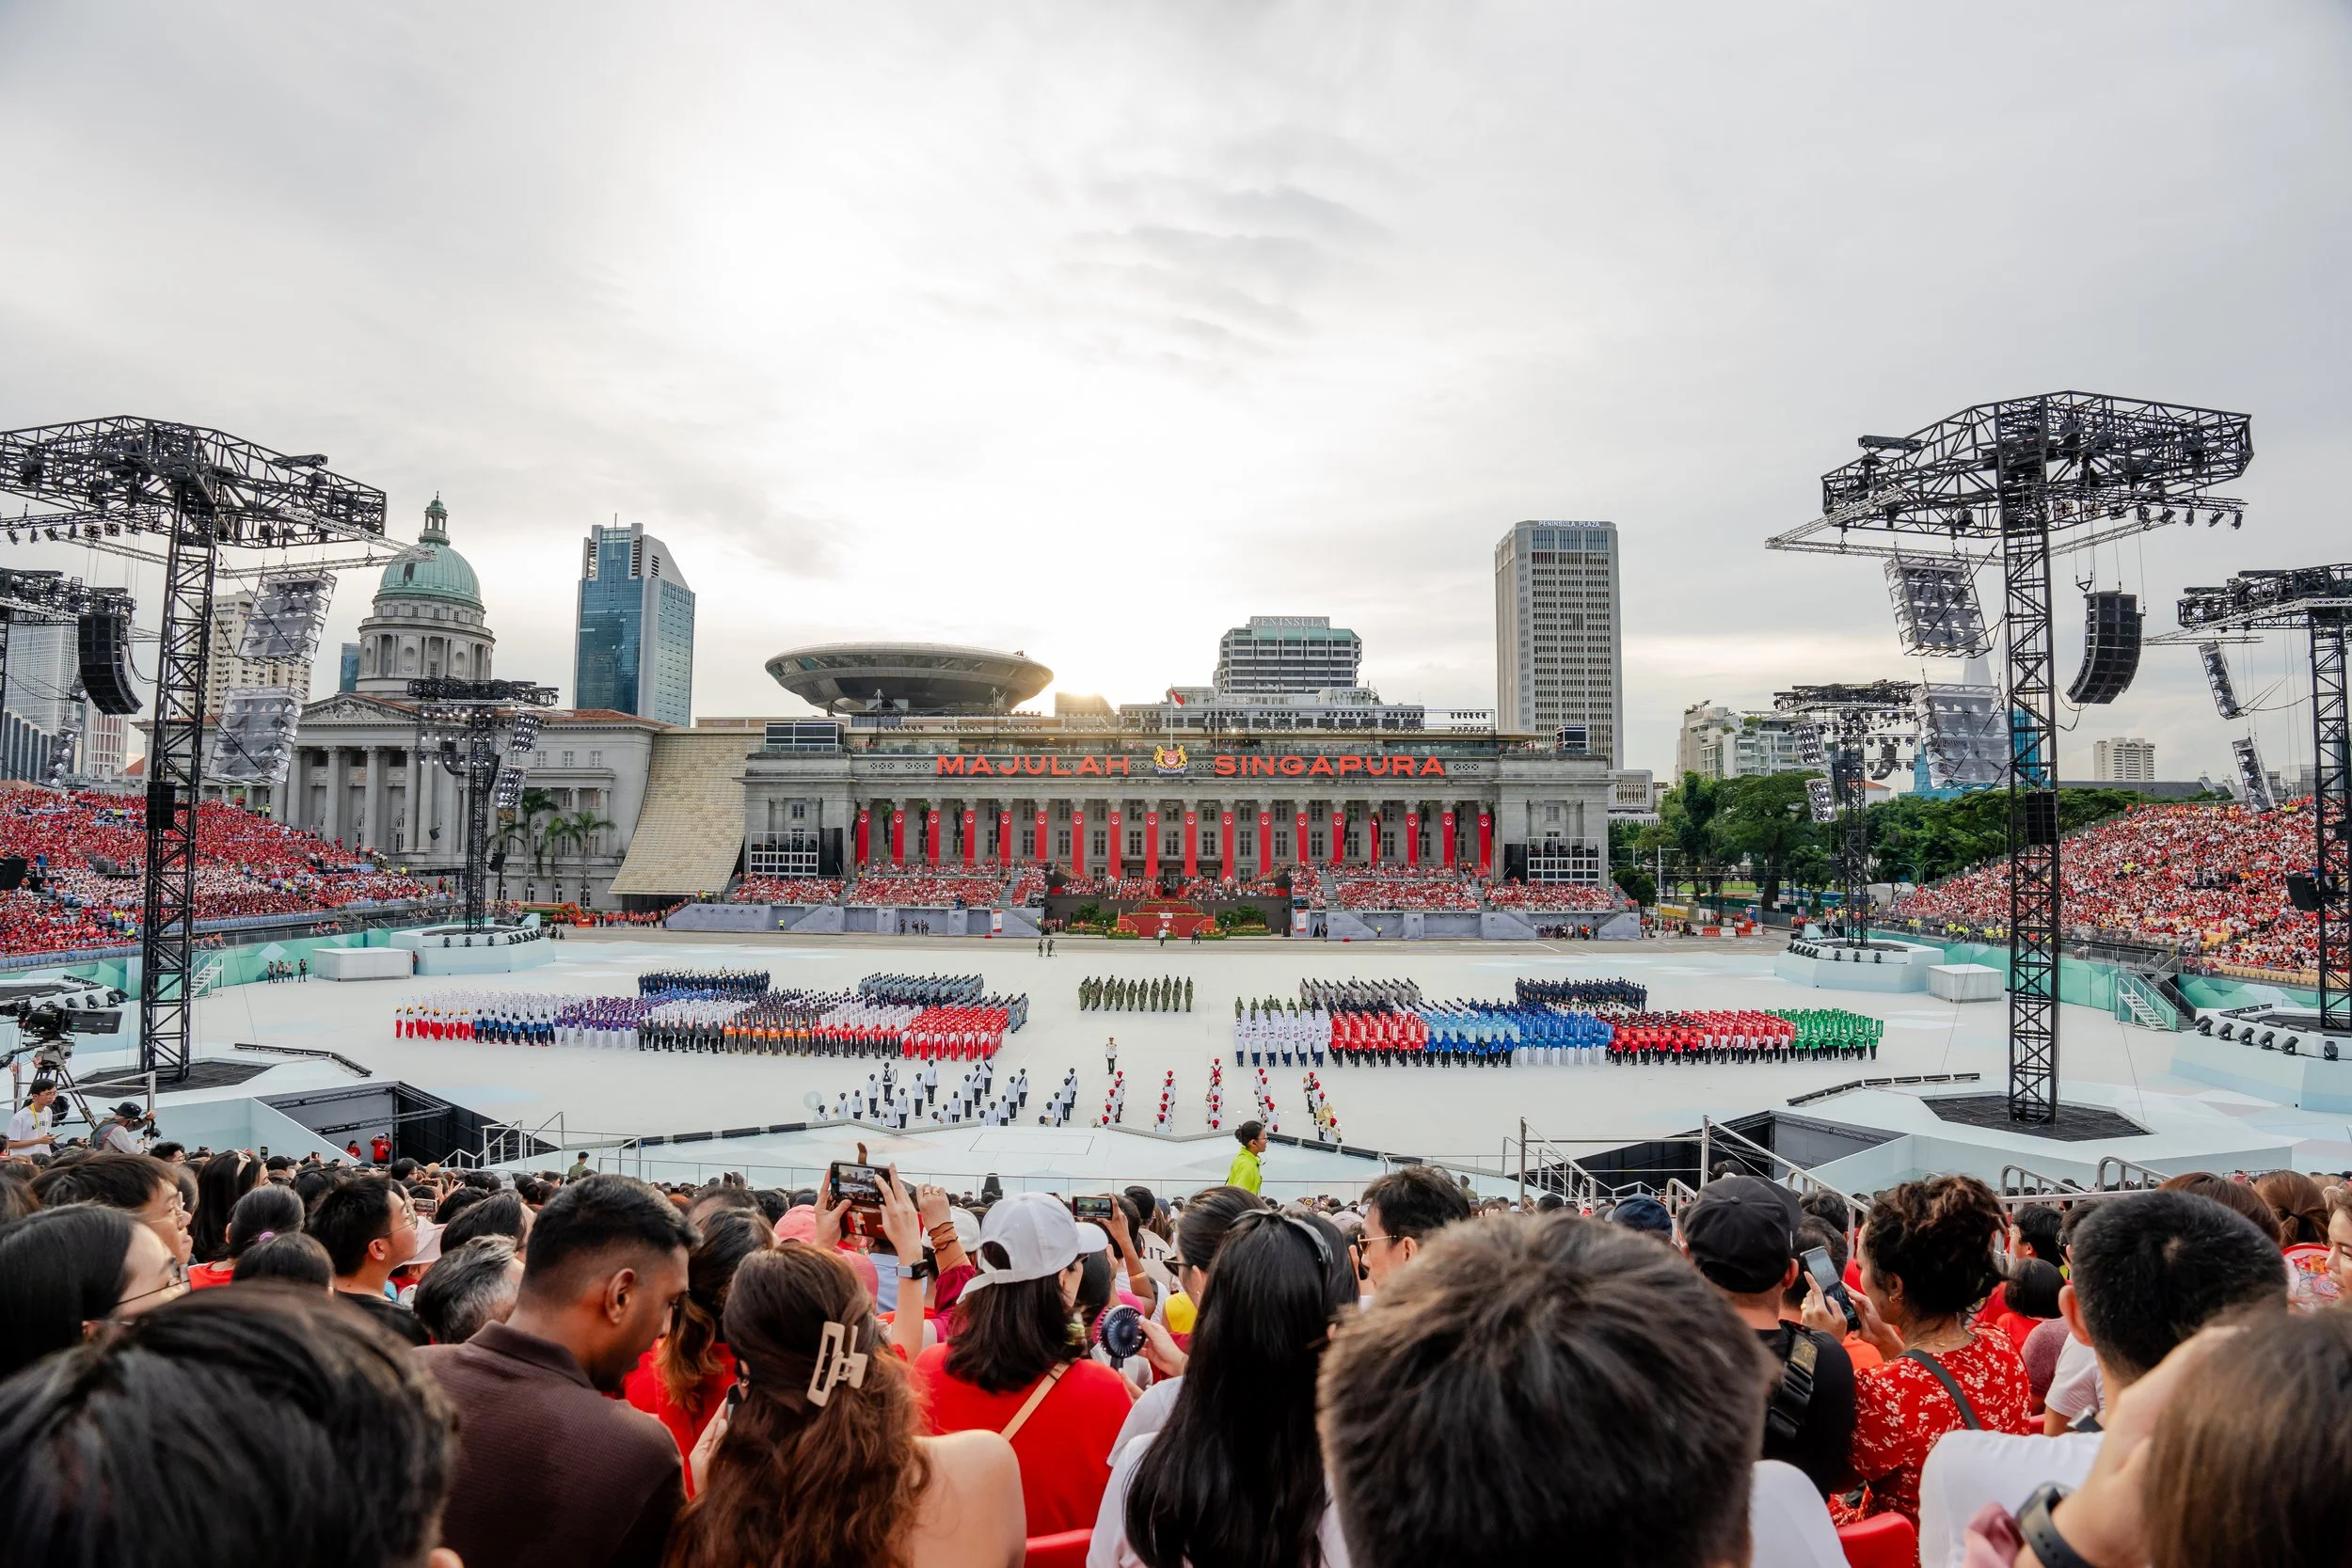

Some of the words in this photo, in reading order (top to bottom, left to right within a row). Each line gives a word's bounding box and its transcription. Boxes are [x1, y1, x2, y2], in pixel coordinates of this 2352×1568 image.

[1253, 617, 1327, 626] PENINSULA
[937, 755, 1129, 775] MAJULAH
[1214, 755, 1446, 776] SINGAPURA
